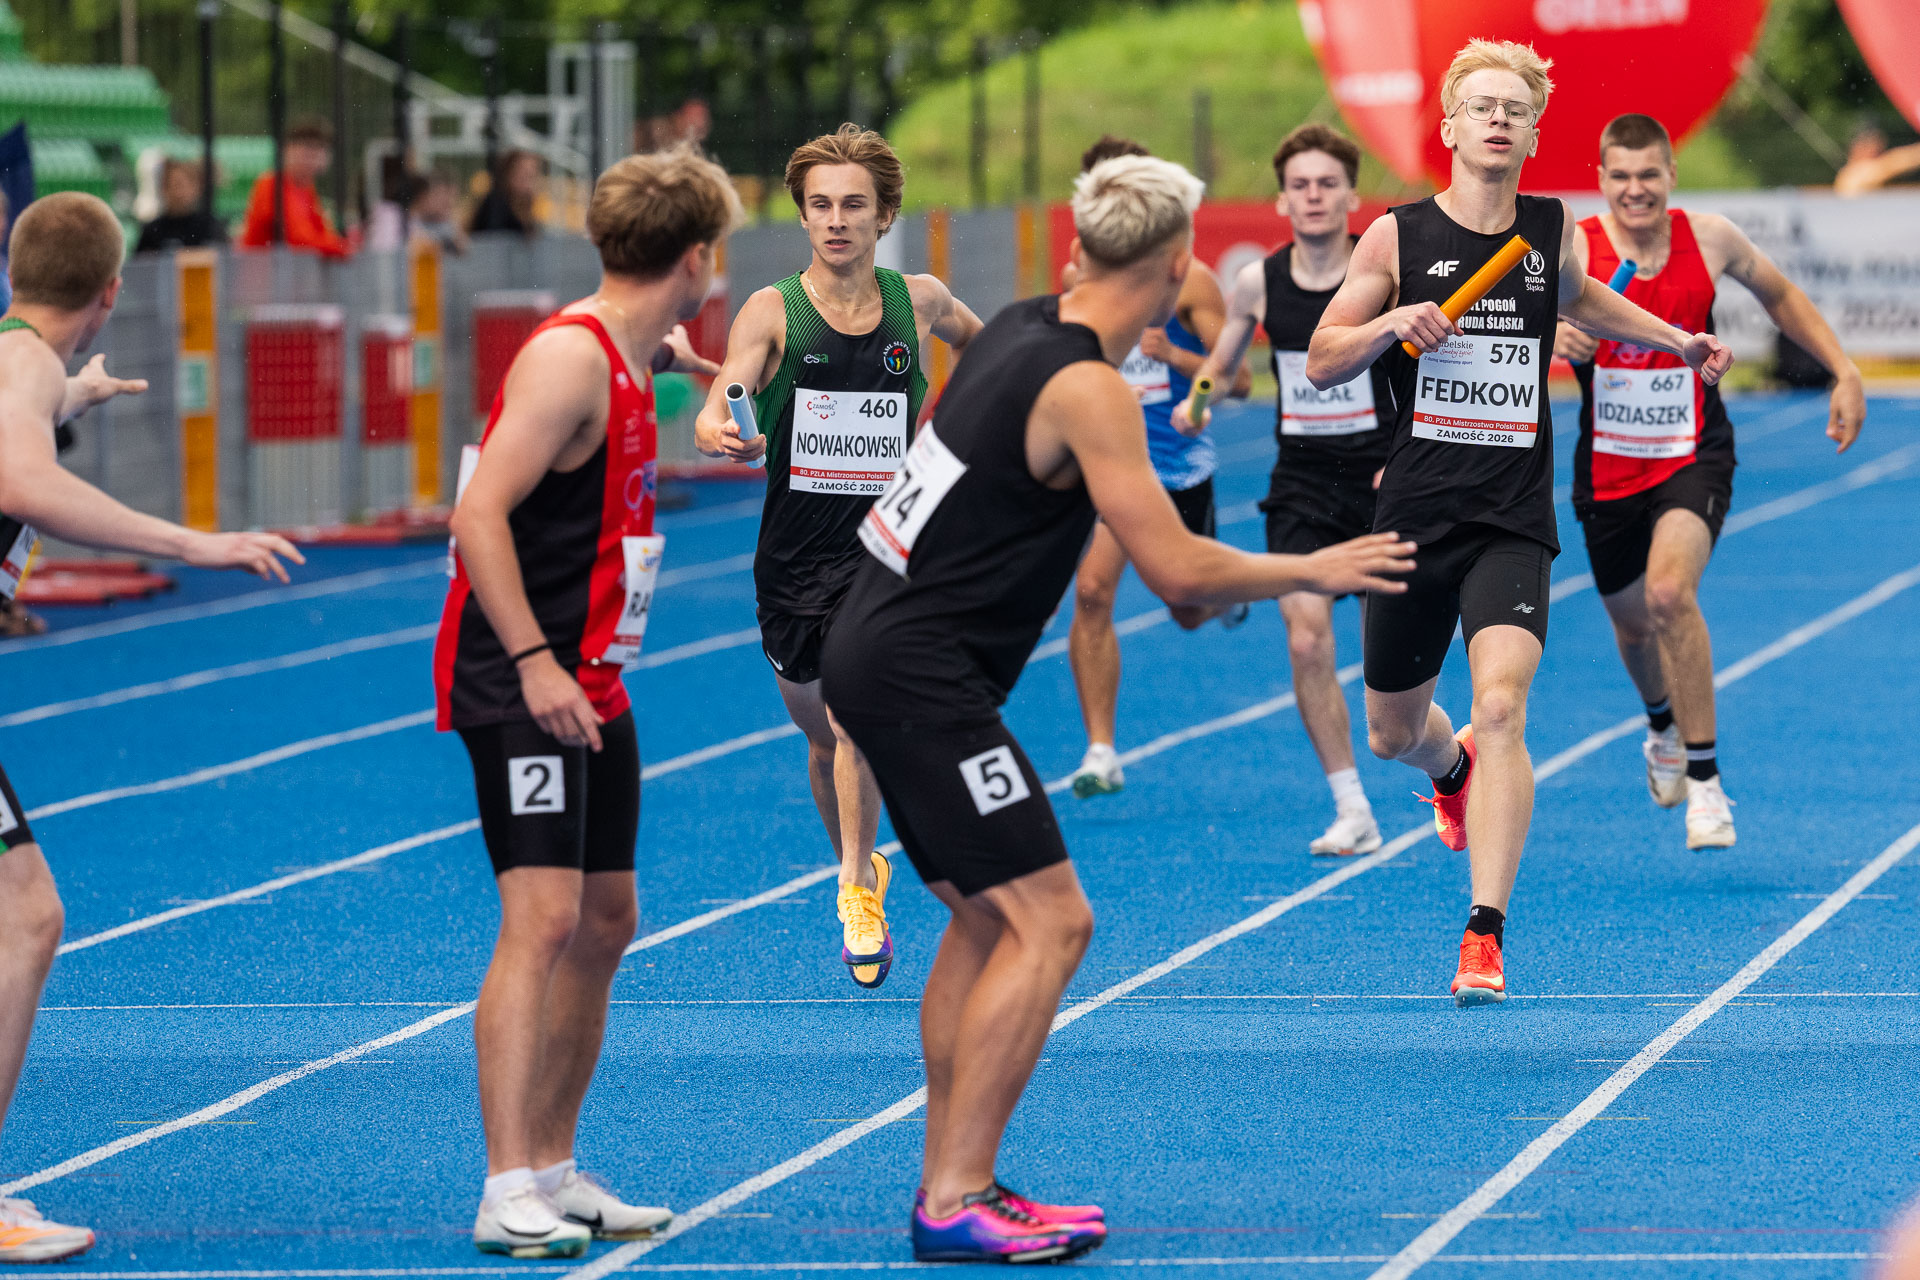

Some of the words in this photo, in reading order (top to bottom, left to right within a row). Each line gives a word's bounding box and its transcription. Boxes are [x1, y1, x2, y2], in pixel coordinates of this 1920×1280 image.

[1525, 276, 1545, 284] RUDA
[1526, 284, 1544, 292] Śląska
[1481, 297, 1516, 312] POGOŃ
[1458, 316, 1484, 329] RUDA
[1487, 314, 1524, 332] ŚLĄSKA
[1489, 343, 1530, 365] 578
[1421, 376, 1534, 408] FEDKOW
[1651, 374, 1684, 392] 667
[812, 402, 835, 411] ZAMOŚĆ
[859, 399, 898, 418] 460
[1598, 402, 1689, 425] IDZIASZEK
[1423, 415, 1435, 424] 80.
[1435, 417, 1452, 426] PZLA
[1453, 419, 1494, 429] Mistrzostwa
[1495, 422, 1515, 431] Polski
[796, 431, 901, 458] NOWAKOWSKI
[1436, 429, 1485, 441] ZAMOŚĆ
[1487, 433, 1514, 443] 2026
[799, 468, 810, 476] 80.
[811, 481, 858, 491] ZAMOŚĆ
[859, 483, 884, 492] 2026
[523, 763, 552, 807] 2
[980, 756, 1012, 800] 5
